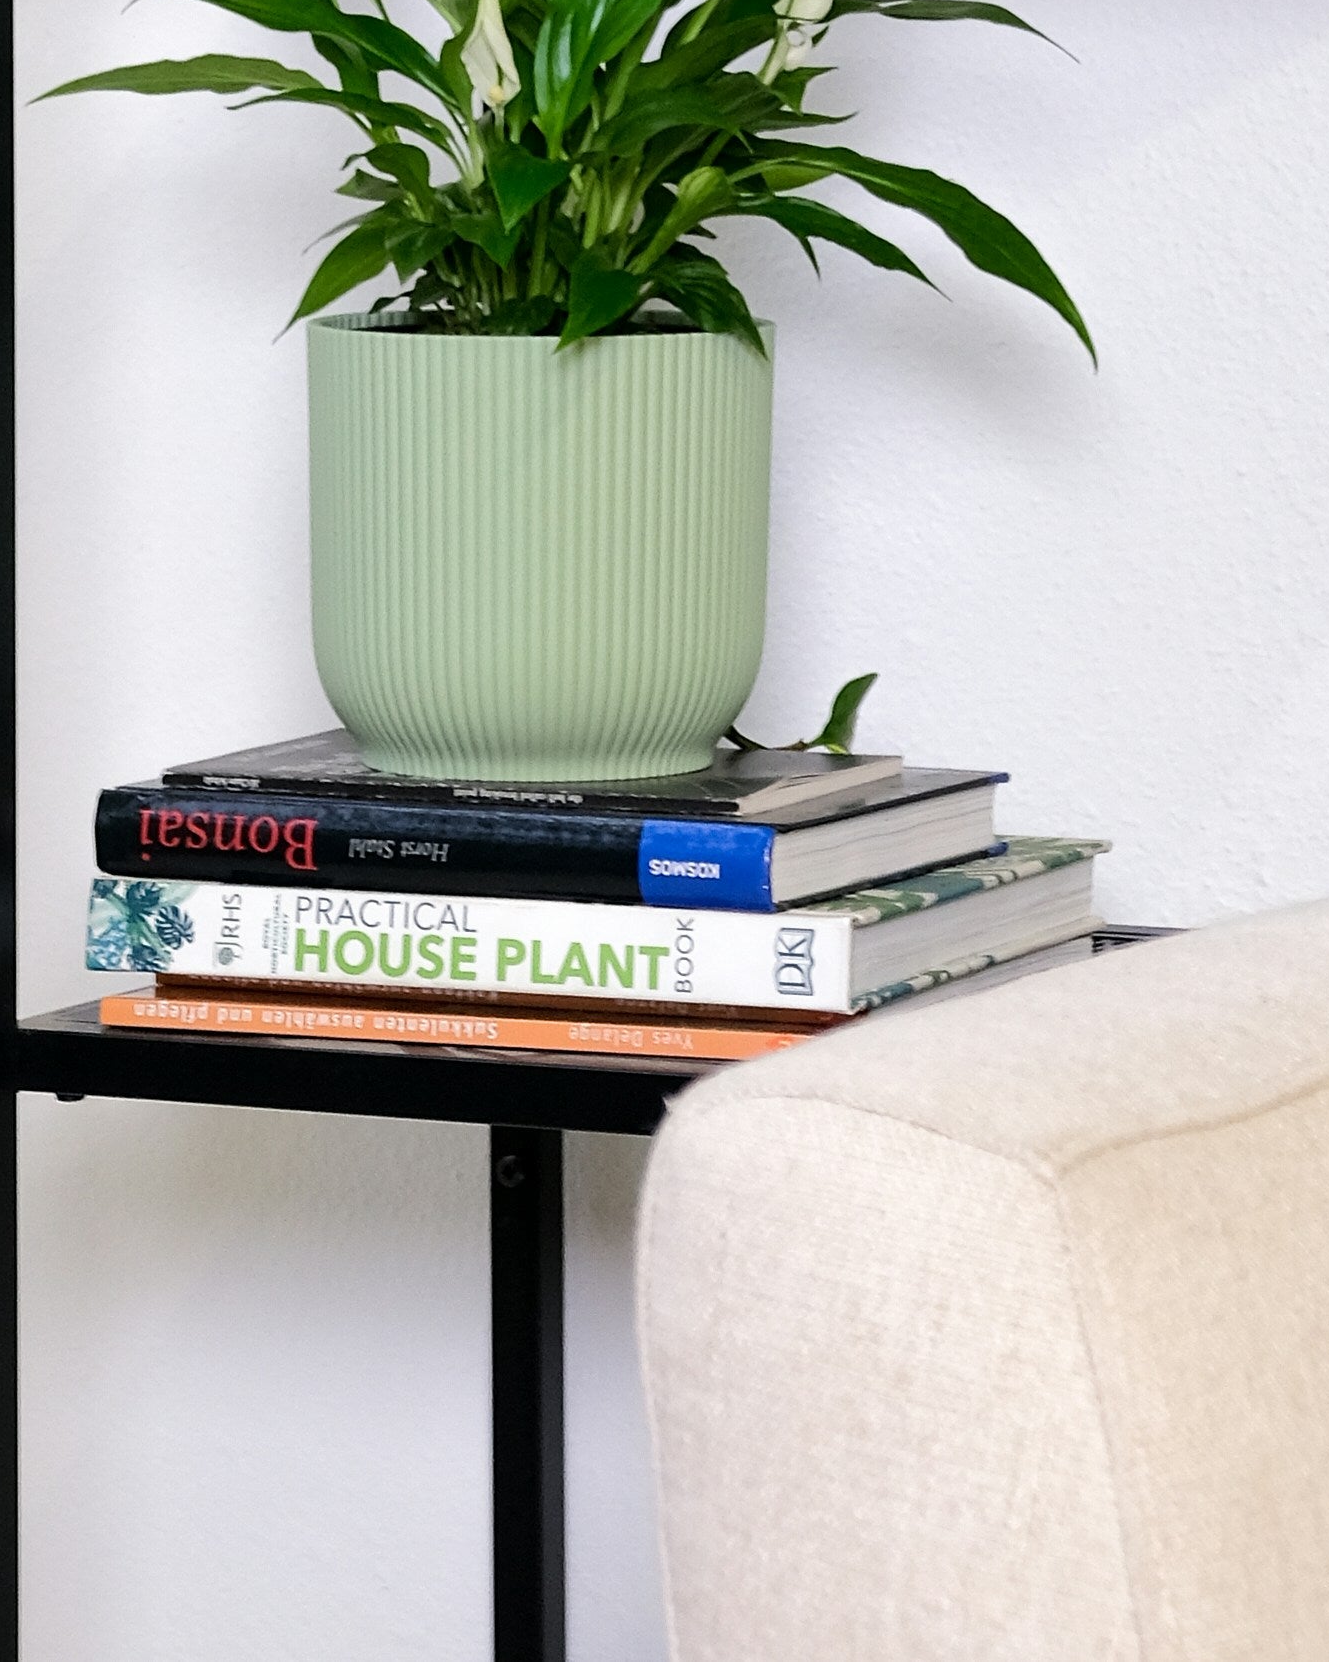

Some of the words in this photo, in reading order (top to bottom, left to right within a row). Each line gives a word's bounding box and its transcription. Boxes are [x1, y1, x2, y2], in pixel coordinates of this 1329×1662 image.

[139, 808, 319, 871] Bonsai
[348, 838, 396, 859] Stahl
[400, 842, 449, 862] Horst
[648, 859, 720, 879] KOSMOS
[222, 892, 242, 937] RHS
[296, 895, 477, 932] PRACTICAL
[294, 928, 477, 981] HOUSE
[497, 938, 670, 991] PLANT
[674, 917, 695, 993] BOOK
[776, 927, 814, 996] DK
[133, 1001, 209, 1024] pflegen
[217, 1007, 252, 1023] und
[261, 1010, 365, 1030] auswählen
[373, 1017, 498, 1040] Sukkulenten
[569, 1024, 643, 1047] Delange
[652, 1031, 694, 1050] Yves
